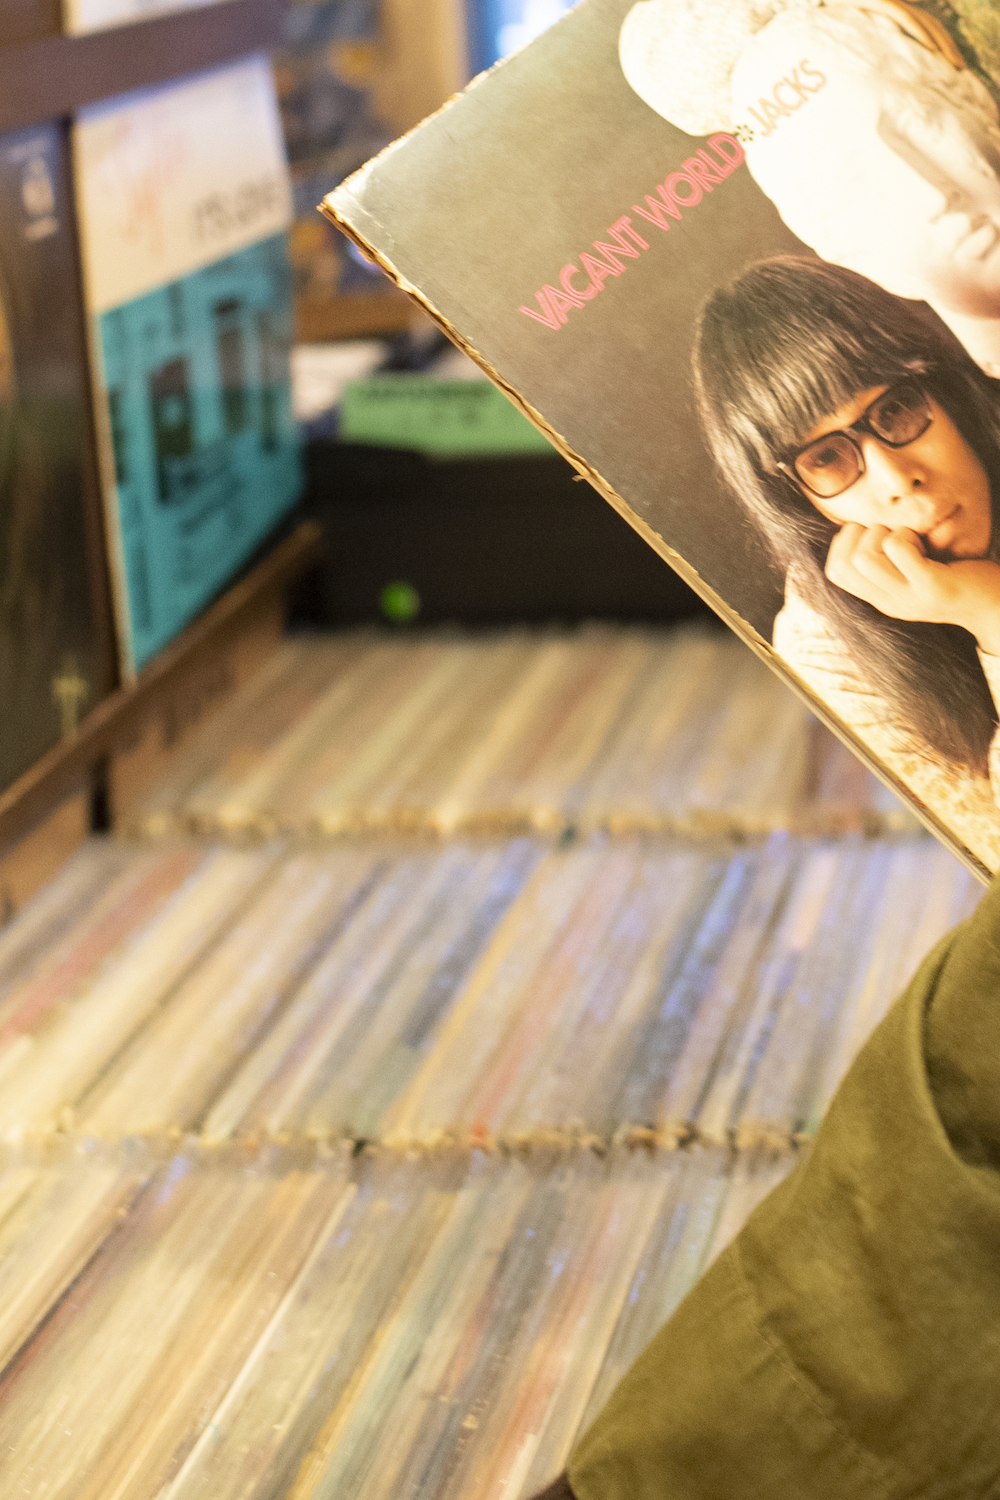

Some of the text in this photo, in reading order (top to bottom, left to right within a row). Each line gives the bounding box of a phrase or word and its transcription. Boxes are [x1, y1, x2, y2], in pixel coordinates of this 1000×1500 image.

[518, 59, 828, 331] VACANT WORLD JACKS
